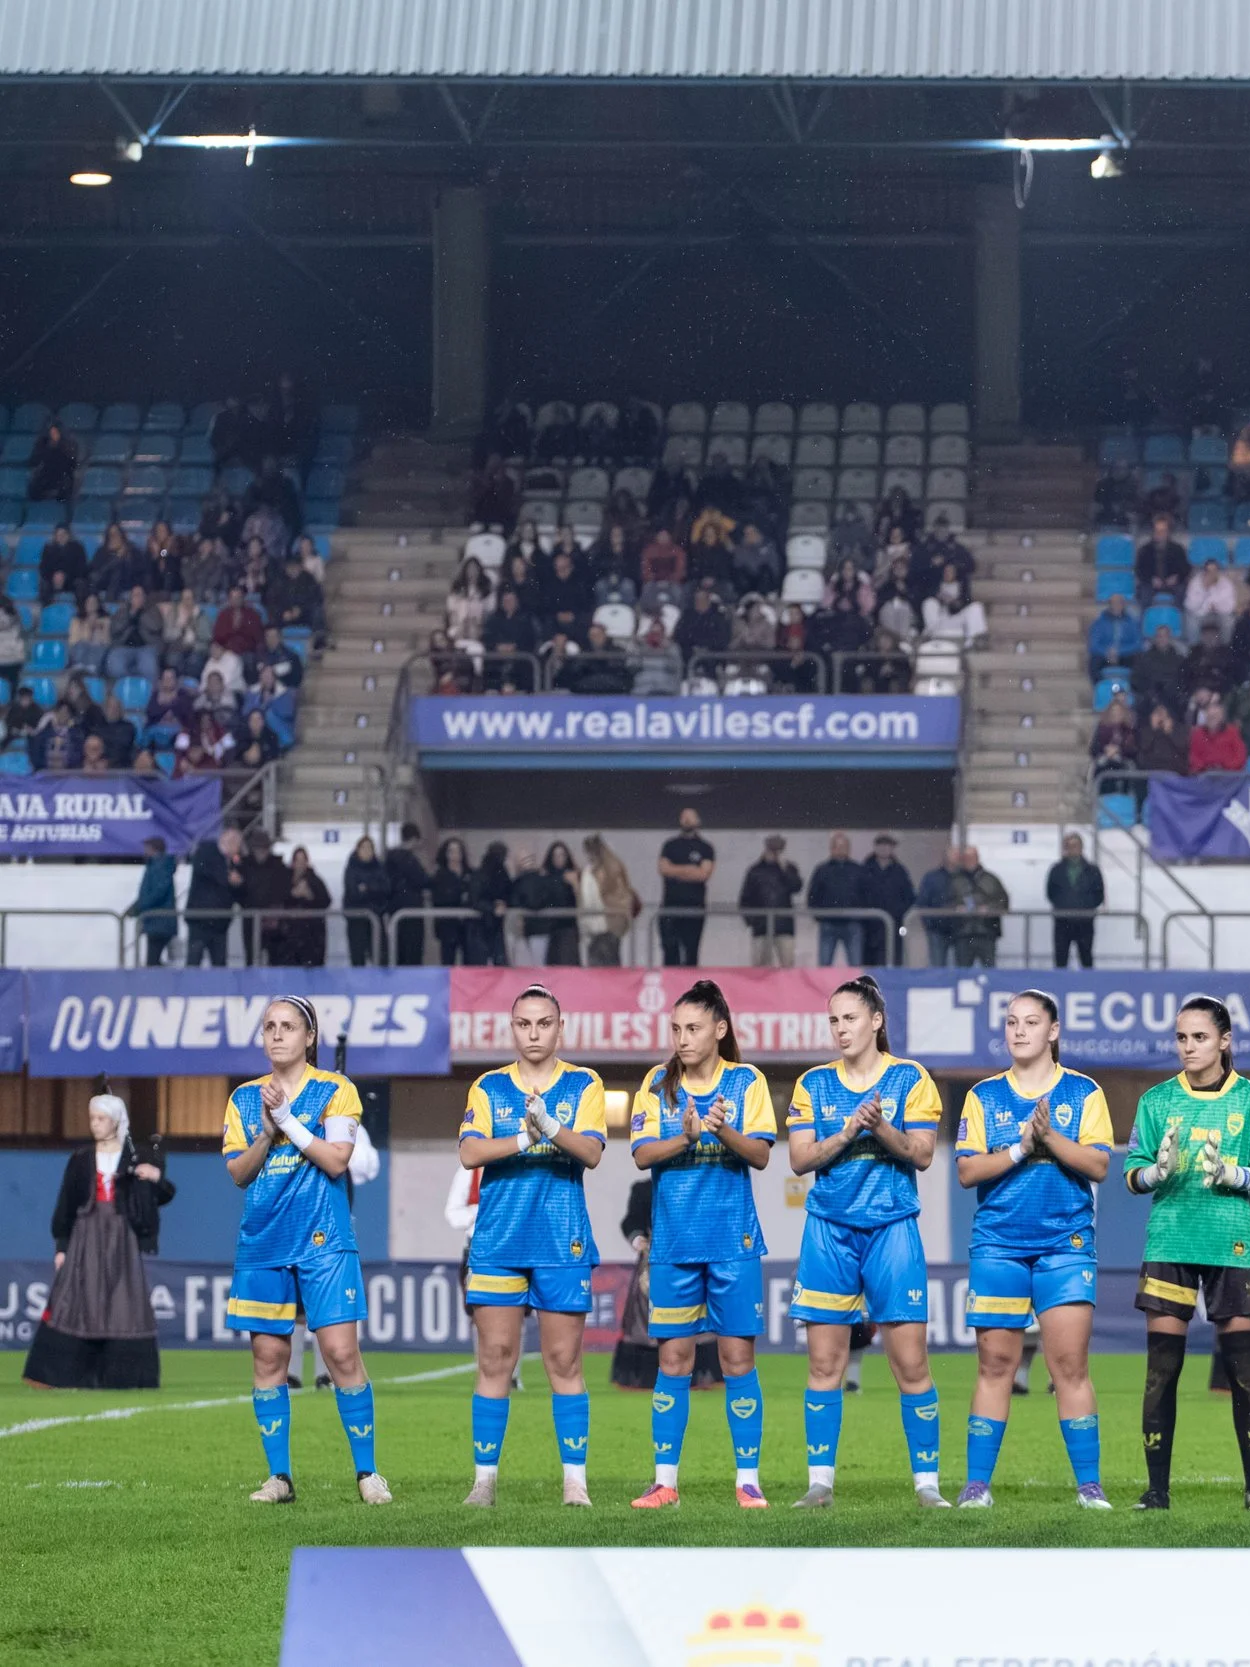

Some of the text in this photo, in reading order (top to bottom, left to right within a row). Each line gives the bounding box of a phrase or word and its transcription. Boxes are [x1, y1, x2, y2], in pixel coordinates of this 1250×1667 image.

[442, 703, 919, 740] www.realavilescf.com
[53, 793, 153, 821] RURAL
[11, 823, 103, 843] ASTURIAS
[127, 993, 430, 1045] NEVRES
[450, 1010, 838, 1050] REA VILES ISTRIA
